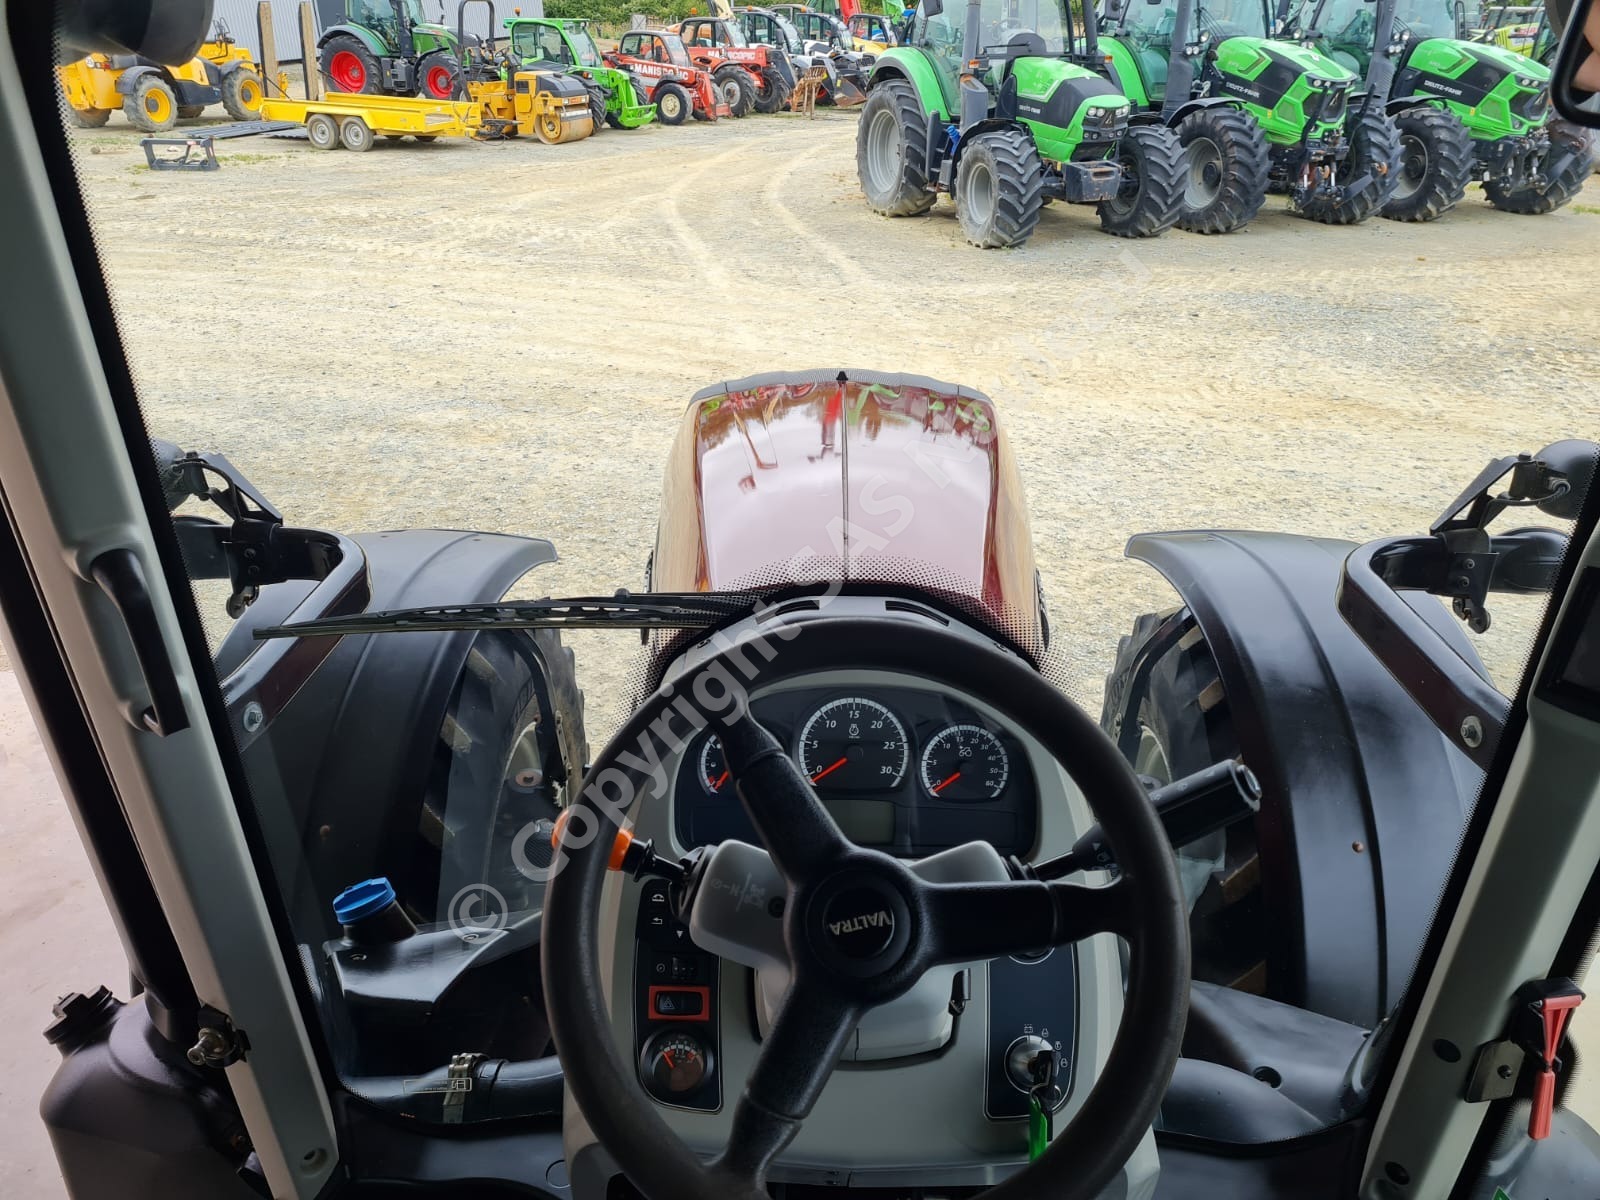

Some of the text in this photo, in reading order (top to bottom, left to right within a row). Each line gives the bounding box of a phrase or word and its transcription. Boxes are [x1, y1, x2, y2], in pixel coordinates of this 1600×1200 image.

[849, 710, 860, 719] 15
[825, 720, 837, 728] 10
[871, 720, 883, 729] 20
[812, 740, 818, 748] 5
[884, 741, 895, 749] 25
[816, 765, 823, 773] 0
[880, 766, 892, 774] 30
[829, 910, 892, 935] VALTRA
